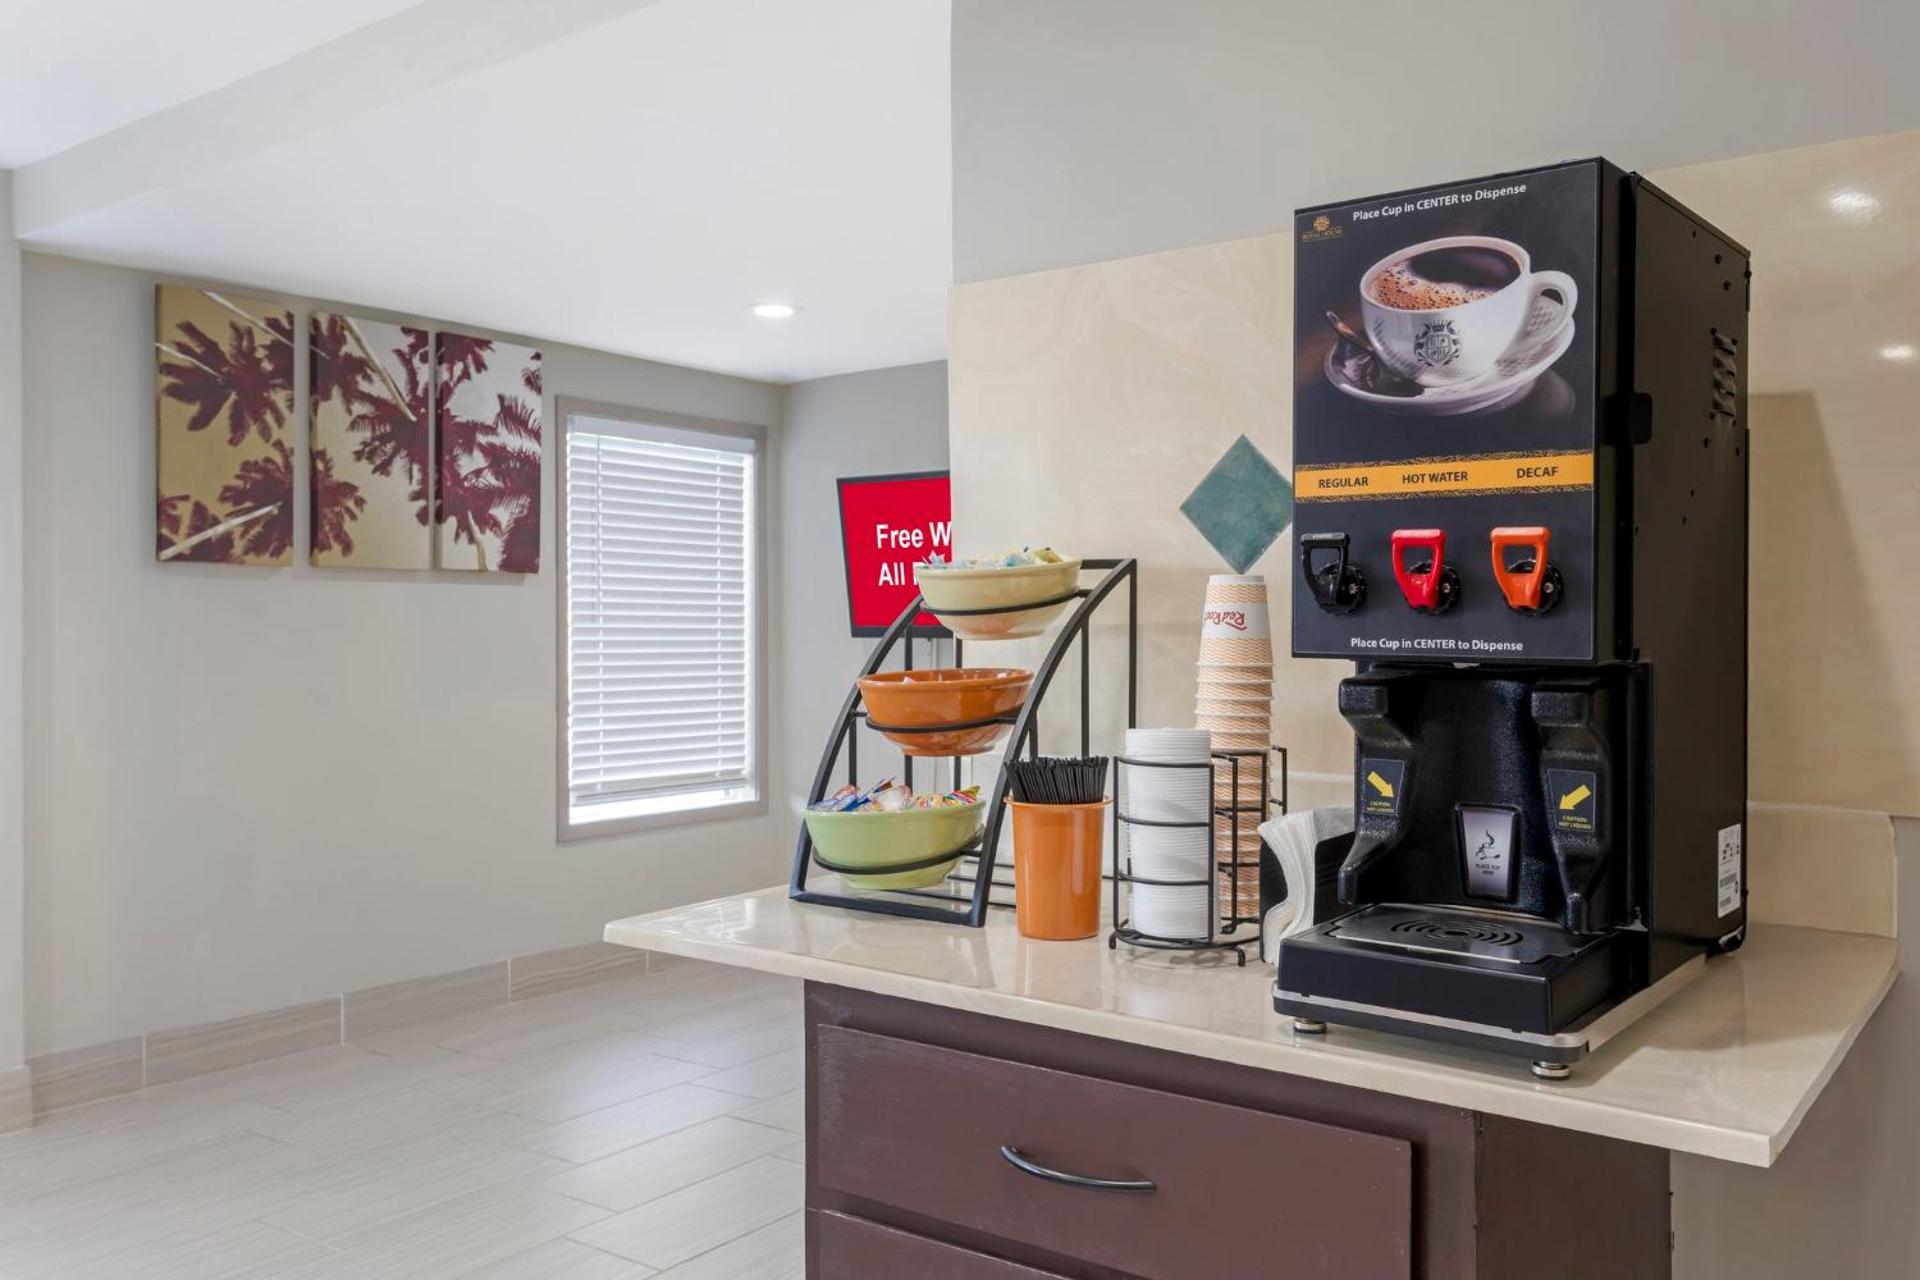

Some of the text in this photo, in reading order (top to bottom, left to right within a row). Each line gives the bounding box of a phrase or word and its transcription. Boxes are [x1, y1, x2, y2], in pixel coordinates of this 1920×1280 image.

[1353, 183, 1527, 221] Place Cup in CENTER to Dispense
[1402, 471, 1468, 485] HOT WATER
[1516, 465, 1560, 479] DECAF
[1318, 476, 1369, 489] REGULAR
[876, 523, 924, 549] Free
[878, 562, 906, 586] All
[1351, 638, 1524, 652] Place Cup in CENTER to Dispense
